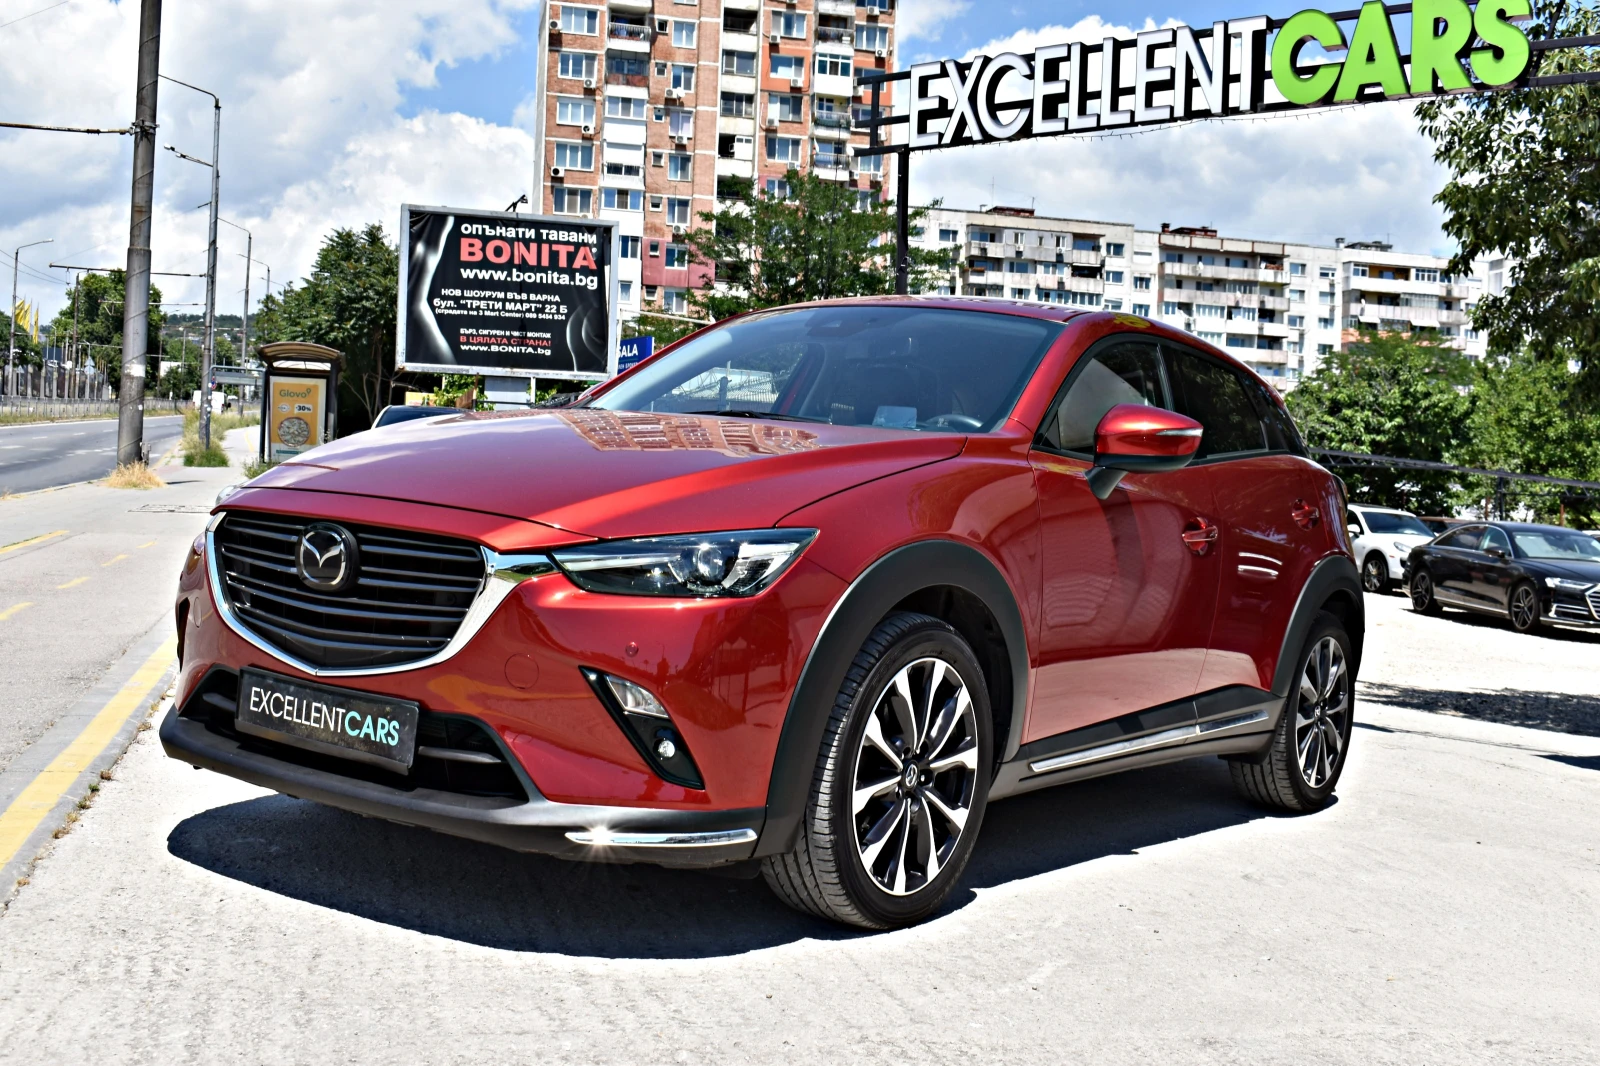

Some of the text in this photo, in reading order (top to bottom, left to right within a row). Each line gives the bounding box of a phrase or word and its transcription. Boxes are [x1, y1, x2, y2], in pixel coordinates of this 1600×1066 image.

[461, 223, 597, 244] опънати тавани
[460, 237, 597, 270] BONITA
[460, 268, 598, 290] www.bonita.bg
[441, 288, 561, 302] НОВ ШОУРУМ ВЪВ ВАРНА
[433, 298, 457, 309] бул.
[544, 304, 558, 313] 22
[560, 305, 568, 314] Б
[460, 335, 551, 347] В ЦЯЛАТА СТРАНА!
[527, 331, 551, 339] МОНТАЖ
[460, 344, 551, 356] www.BONITA.bg
[279, 388, 308, 398] Glovo
